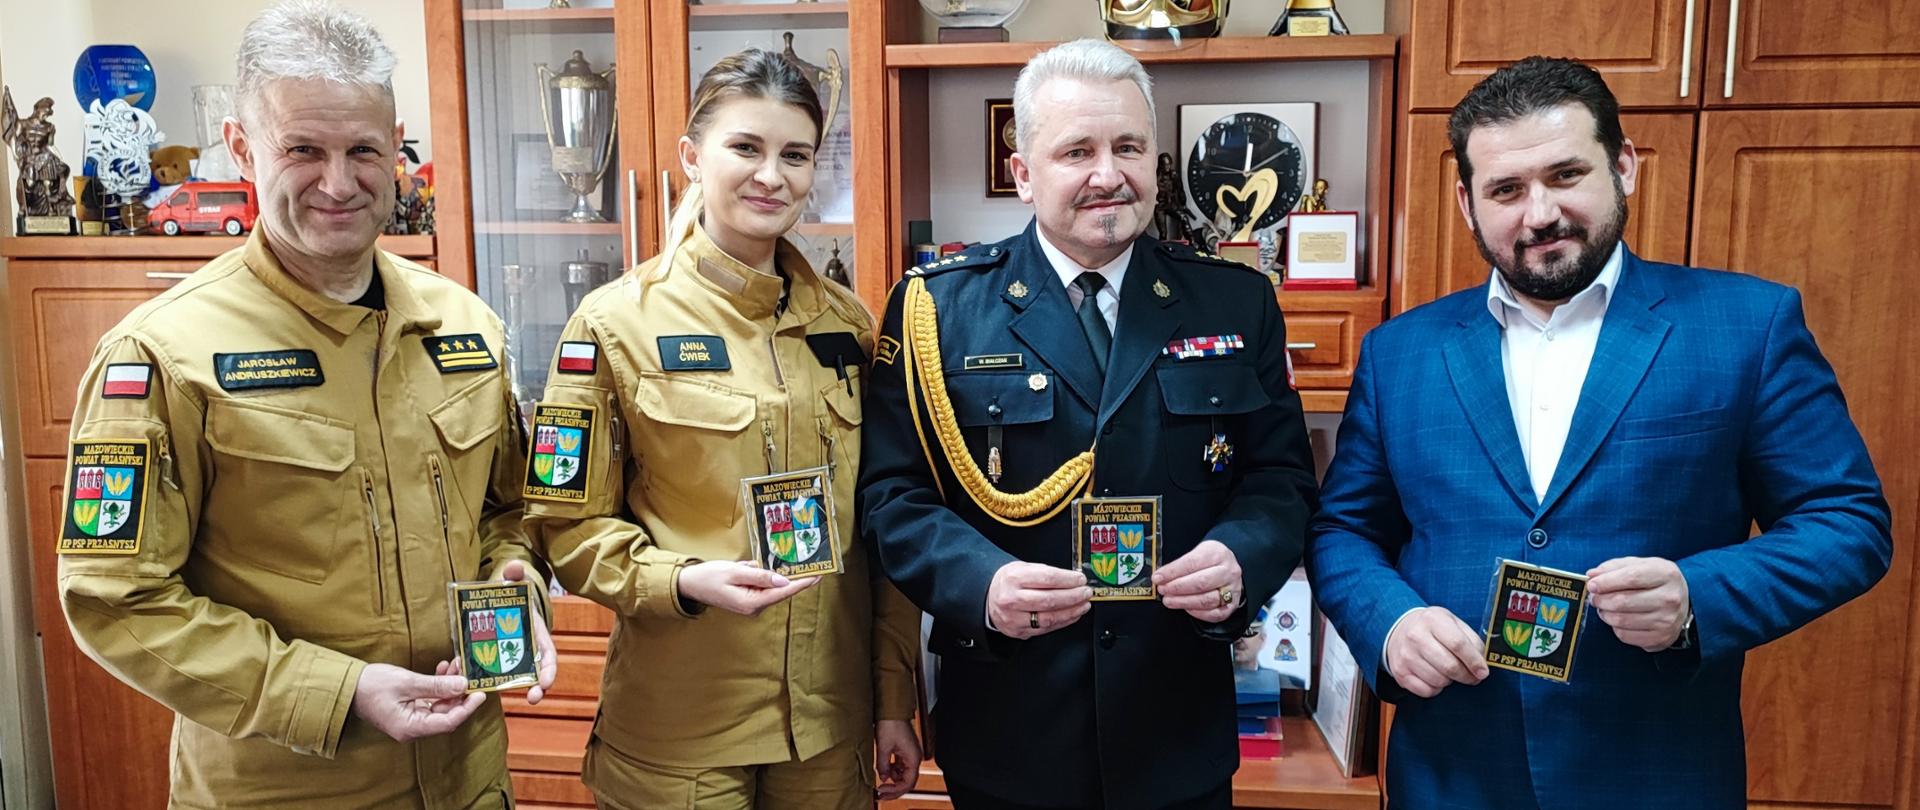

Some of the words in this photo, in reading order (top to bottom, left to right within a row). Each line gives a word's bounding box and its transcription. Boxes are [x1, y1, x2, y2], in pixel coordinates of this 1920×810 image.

[680, 342, 707, 351] ANNA
[679, 350, 711, 361] ĆWIEK
[237, 357, 297, 369] JAROSŁAW
[225, 368, 317, 382] ANDRUSZKIEWICZ
[83, 445, 135, 455] MAZOWIECKIE
[74, 455, 98, 465] POWIAT
[100, 455, 144, 465] PRZASNYSKI
[763, 479, 812, 494] MAZOWIECKIE
[756, 492, 781, 504] POWIAT
[1093, 505, 1142, 513] MAZOWIECKIE
[1085, 514, 1110, 523] POWIAT
[1112, 513, 1151, 522] PRZASNYSKI
[72, 538, 87, 549] PSP
[86, 538, 135, 549] PRZASNYSZ
[791, 560, 833, 575] PRZASNYSZ
[1517, 570, 1572, 589] MAZOWIECKIE
[1506, 577, 1533, 591] POWIAT
[1536, 584, 1579, 600] PRZASNYSKI
[1500, 655, 1516, 665] PSP
[1516, 657, 1564, 676] PRZASNYSZ
